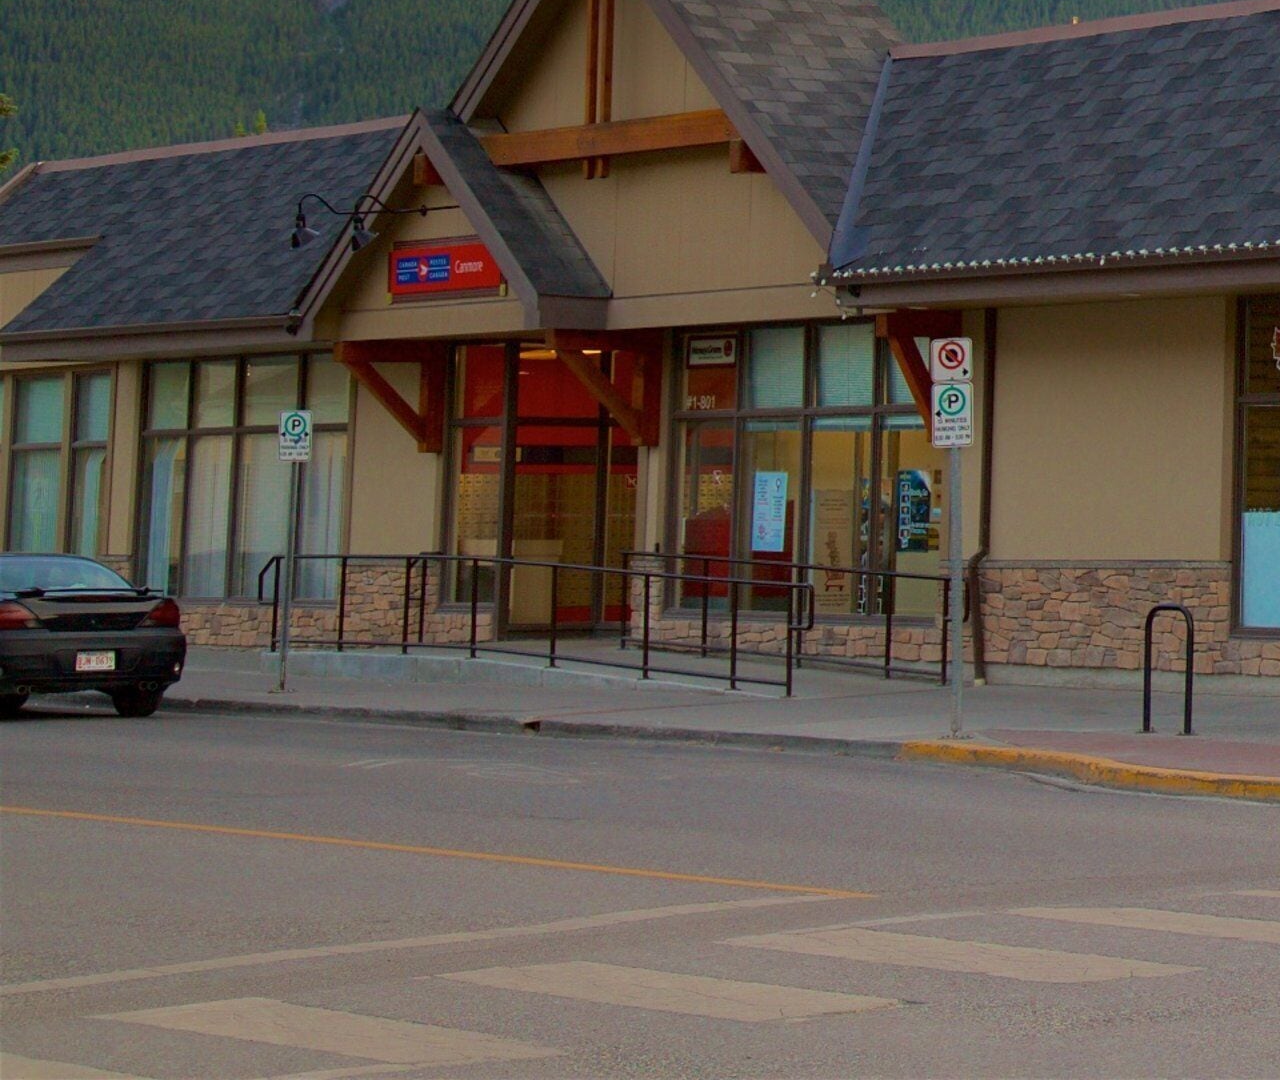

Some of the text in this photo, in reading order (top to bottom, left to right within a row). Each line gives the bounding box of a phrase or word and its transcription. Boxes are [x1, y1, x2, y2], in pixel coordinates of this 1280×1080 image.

[454, 260, 484, 274] Canmore
[947, 393, 960, 409] P
[292, 418, 302, 431] P
